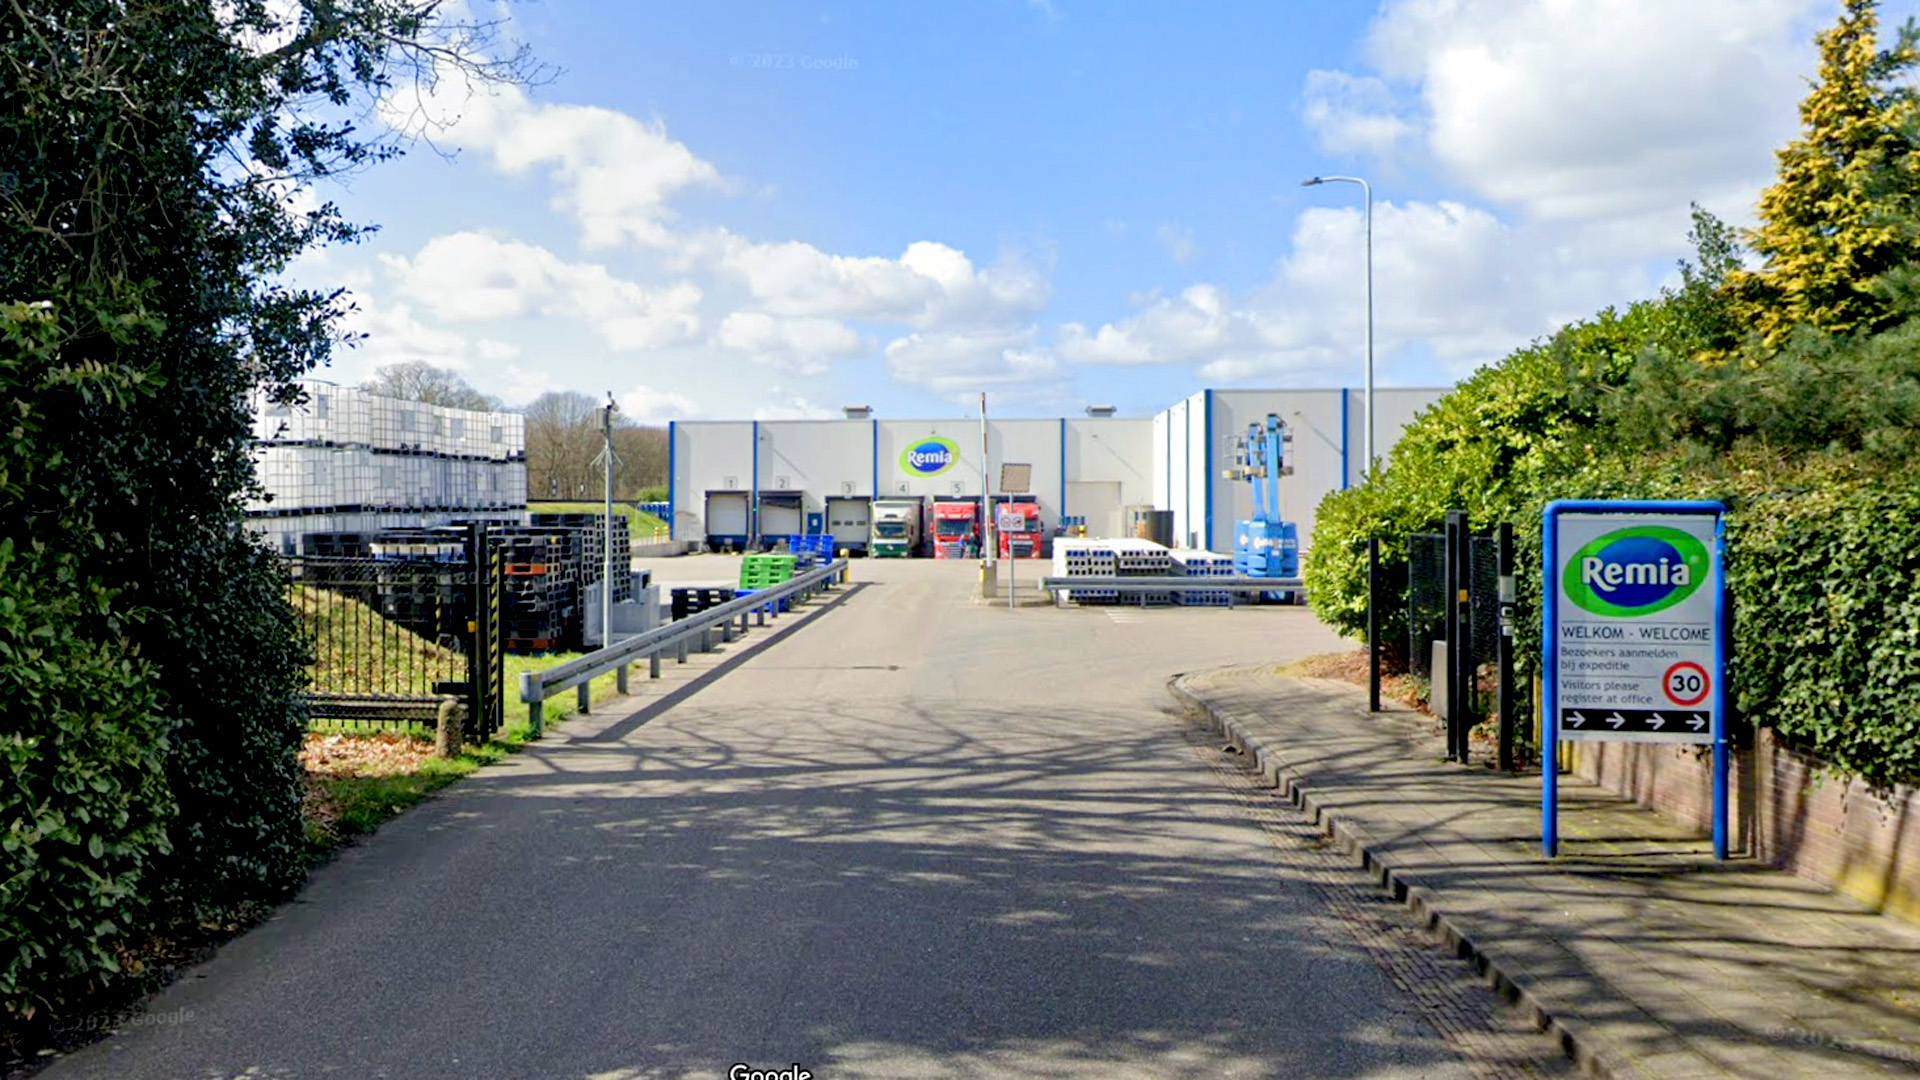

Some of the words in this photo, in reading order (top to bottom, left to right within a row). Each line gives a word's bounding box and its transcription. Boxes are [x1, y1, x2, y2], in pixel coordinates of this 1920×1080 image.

[907, 450, 953, 467] Remia
[778, 478, 786, 489] 2
[845, 483, 852, 494] 3
[898, 484, 907, 493] 4
[953, 484, 961, 493] 5
[1581, 556, 1691, 593] Remia
[1561, 626, 1625, 640] WELKOM
[1639, 627, 1711, 641] WELCOME
[1560, 646, 1616, 659] Bezoekers
[1618, 648, 1679, 659] aanmelden
[1560, 660, 1576, 672] bij
[1578, 661, 1631, 672] expeditie
[1560, 680, 1601, 691] Visitors
[1603, 681, 1641, 693] please
[1672, 674, 1701, 693] 30
[1560, 693, 1602, 705] register
[1605, 694, 1617, 704] at
[1620, 693, 1654, 705] office
